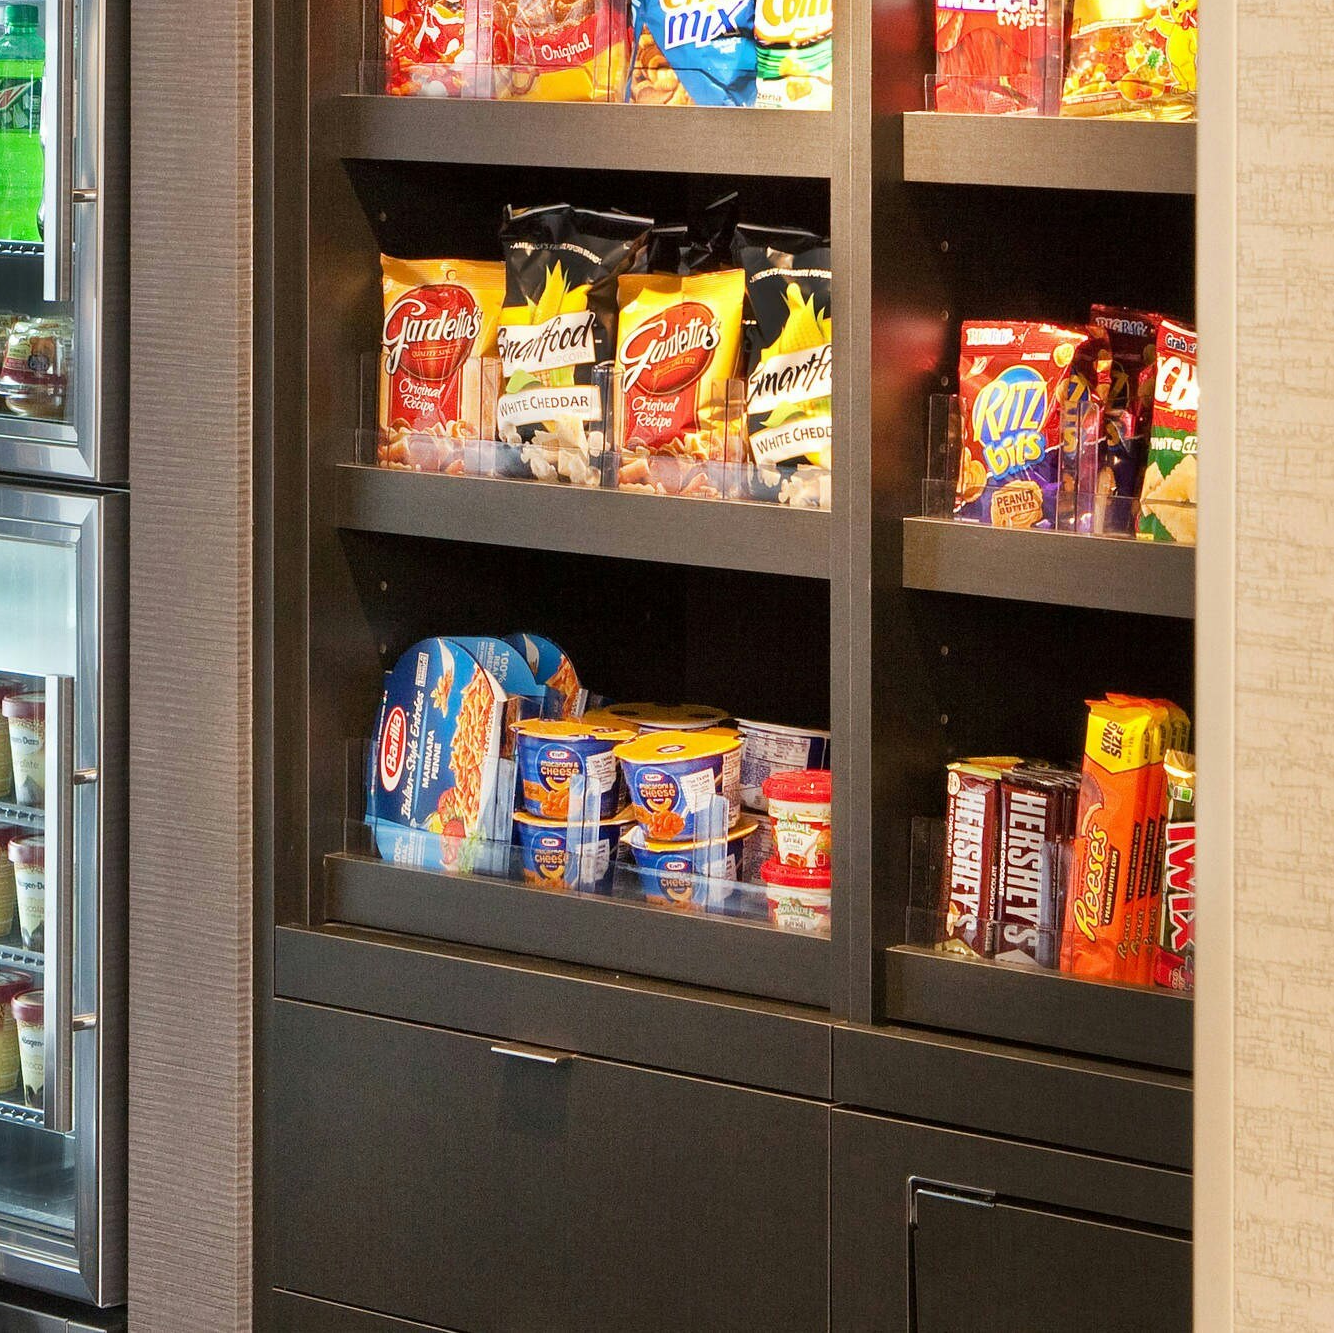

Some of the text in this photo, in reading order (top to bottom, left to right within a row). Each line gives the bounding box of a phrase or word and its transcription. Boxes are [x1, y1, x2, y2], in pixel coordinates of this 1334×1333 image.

[541, 33, 592, 62] Original
[383, 298, 483, 375] Gardetto's
[498, 313, 595, 363] Smartfood
[1167, 334, 1187, 351] Grab
[619, 317, 721, 394] Gardetto's
[399, 377, 446, 401] Original
[401, 394, 435, 416] Recipe
[631, 396, 680, 416] Original
[500, 395, 589, 418] WHITE CHEDDAR
[633, 412, 672, 433] Recipe
[973, 380, 1048, 442] RITZ
[756, 433, 792, 455] WHITE
[985, 433, 1044, 477] bits
[996, 489, 1035, 508] PEANUT
[999, 502, 1036, 516] BUTTER
[385, 713, 402, 772] Barilla
[1101, 721, 1118, 754] KING
[1110, 725, 1126, 759] SIZE
[422, 729, 436, 788] MARINARA
[431, 742, 442, 780] PENNE
[549, 751, 567, 759] Kraft
[401, 740, 418, 820] Italian-Style
[946, 813, 955, 858] CHOCOLATE
[998, 847, 1006, 897] CHOCOLATE
[1074, 824, 1108, 943] Reese's
